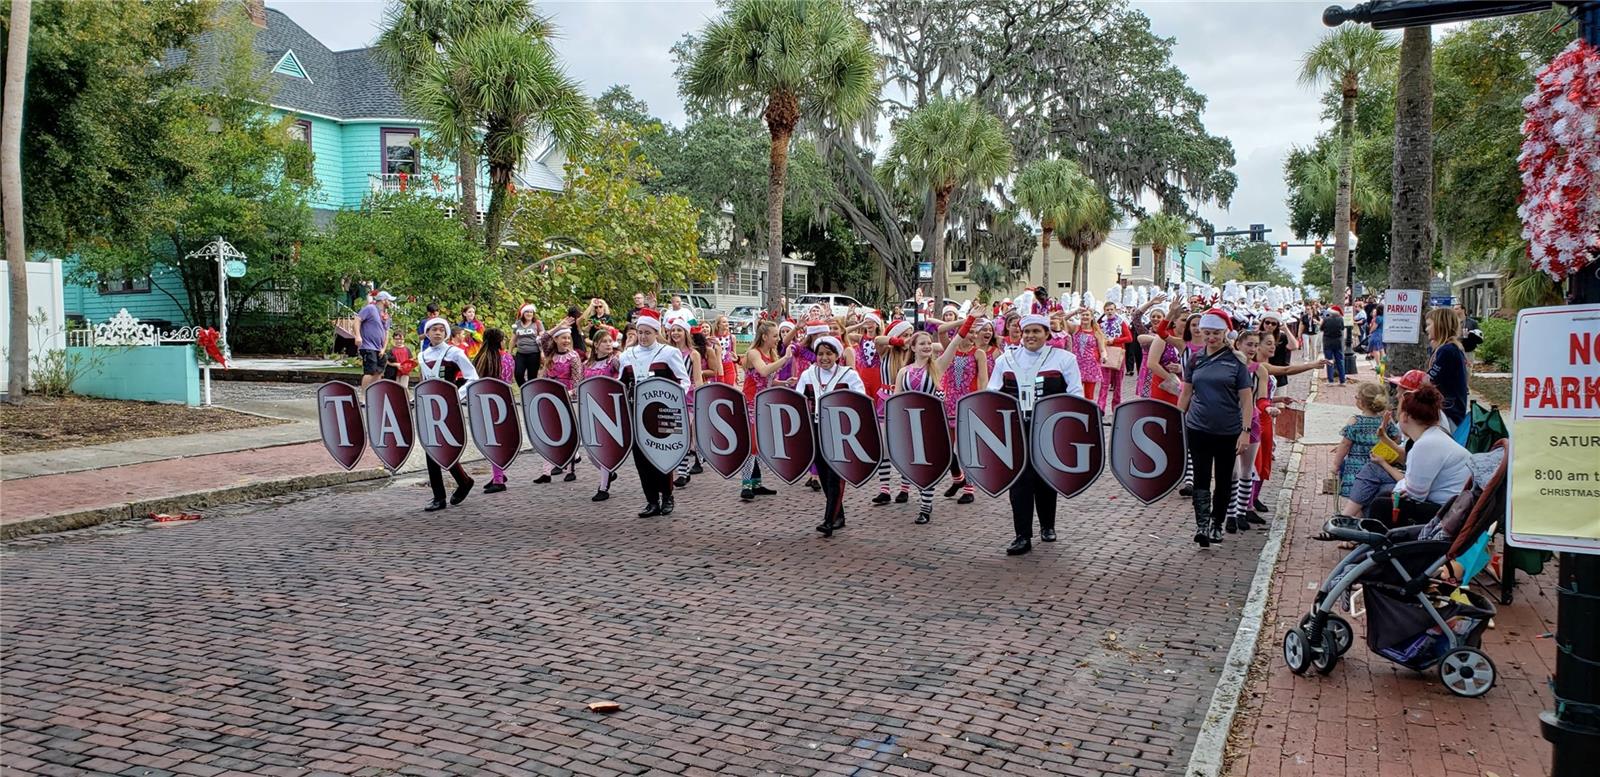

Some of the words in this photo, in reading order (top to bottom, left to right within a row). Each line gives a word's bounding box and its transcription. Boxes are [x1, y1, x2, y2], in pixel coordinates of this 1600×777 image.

[1397, 293, 1408, 302] NO
[1387, 304, 1418, 313] PARKING
[642, 391, 678, 401] TARPON
[645, 439, 683, 450] SPRINGS
[1534, 469, 1563, 481] 8:00
[1567, 472, 1589, 481] am
[1539, 487, 1600, 498] CHRISTMAS
